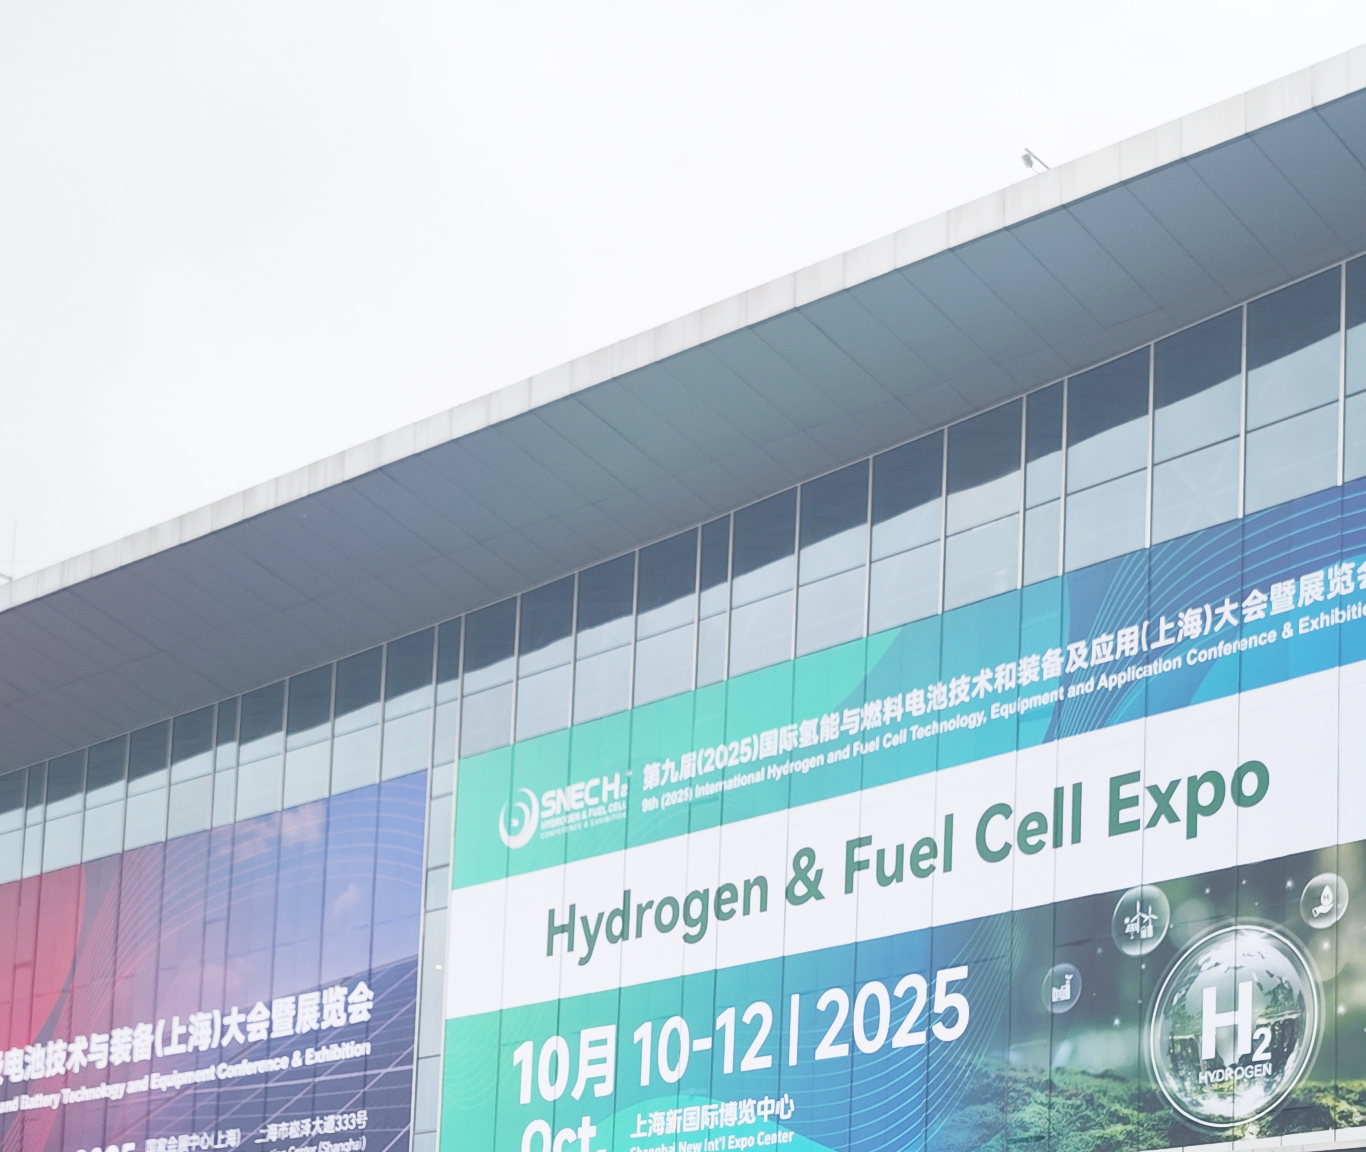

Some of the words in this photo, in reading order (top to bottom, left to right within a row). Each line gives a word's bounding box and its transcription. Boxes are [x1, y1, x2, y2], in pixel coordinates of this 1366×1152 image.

[642, 795, 659, 812] 9th
[660, 787, 693, 811] (2025)
[695, 766, 765, 799] International
[767, 756, 825, 782] Hydrogen
[827, 747, 850, 765] and
[852, 740, 880, 758] Fuel
[882, 729, 907, 749] Cell
[910, 709, 987, 741] Technology,
[990, 685, 1065, 722] Equipment
[1067, 677, 1095, 700] and
[1097, 655, 1183, 692] Application
[1186, 628, 1277, 667] Conference
[1281, 621, 1294, 640] &
[546, 875, 768, 967] Hydrogen
[785, 847, 826, 906] &
[844, 813, 954, 895] Fuel
[975, 781, 1082, 863] Cell
[1107, 759, 1271, 840] Expo
[512, 1023, 617, 1105] 10月
[633, 1001, 773, 1087] 10-12
[814, 965, 970, 1061] 2025
[20, 1092, 61, 1111] Battery
[62, 1079, 125, 1106] Technology
[126, 1073, 148, 1093] and
[150, 1066, 216, 1091] Equipment
[216, 1055, 290, 1080] Conference
[291, 1050, 303, 1068] &
[304, 1041, 371, 1066] Exhibition
[1198, 1062, 1273, 1085] HYDROGEN
[630, 1093, 795, 1139] 上海新国际博览中心
[704, 1136, 725, 1152] Int'l
[728, 1134, 754, 1151] Expo
[757, 1130, 794, 1146] Center
